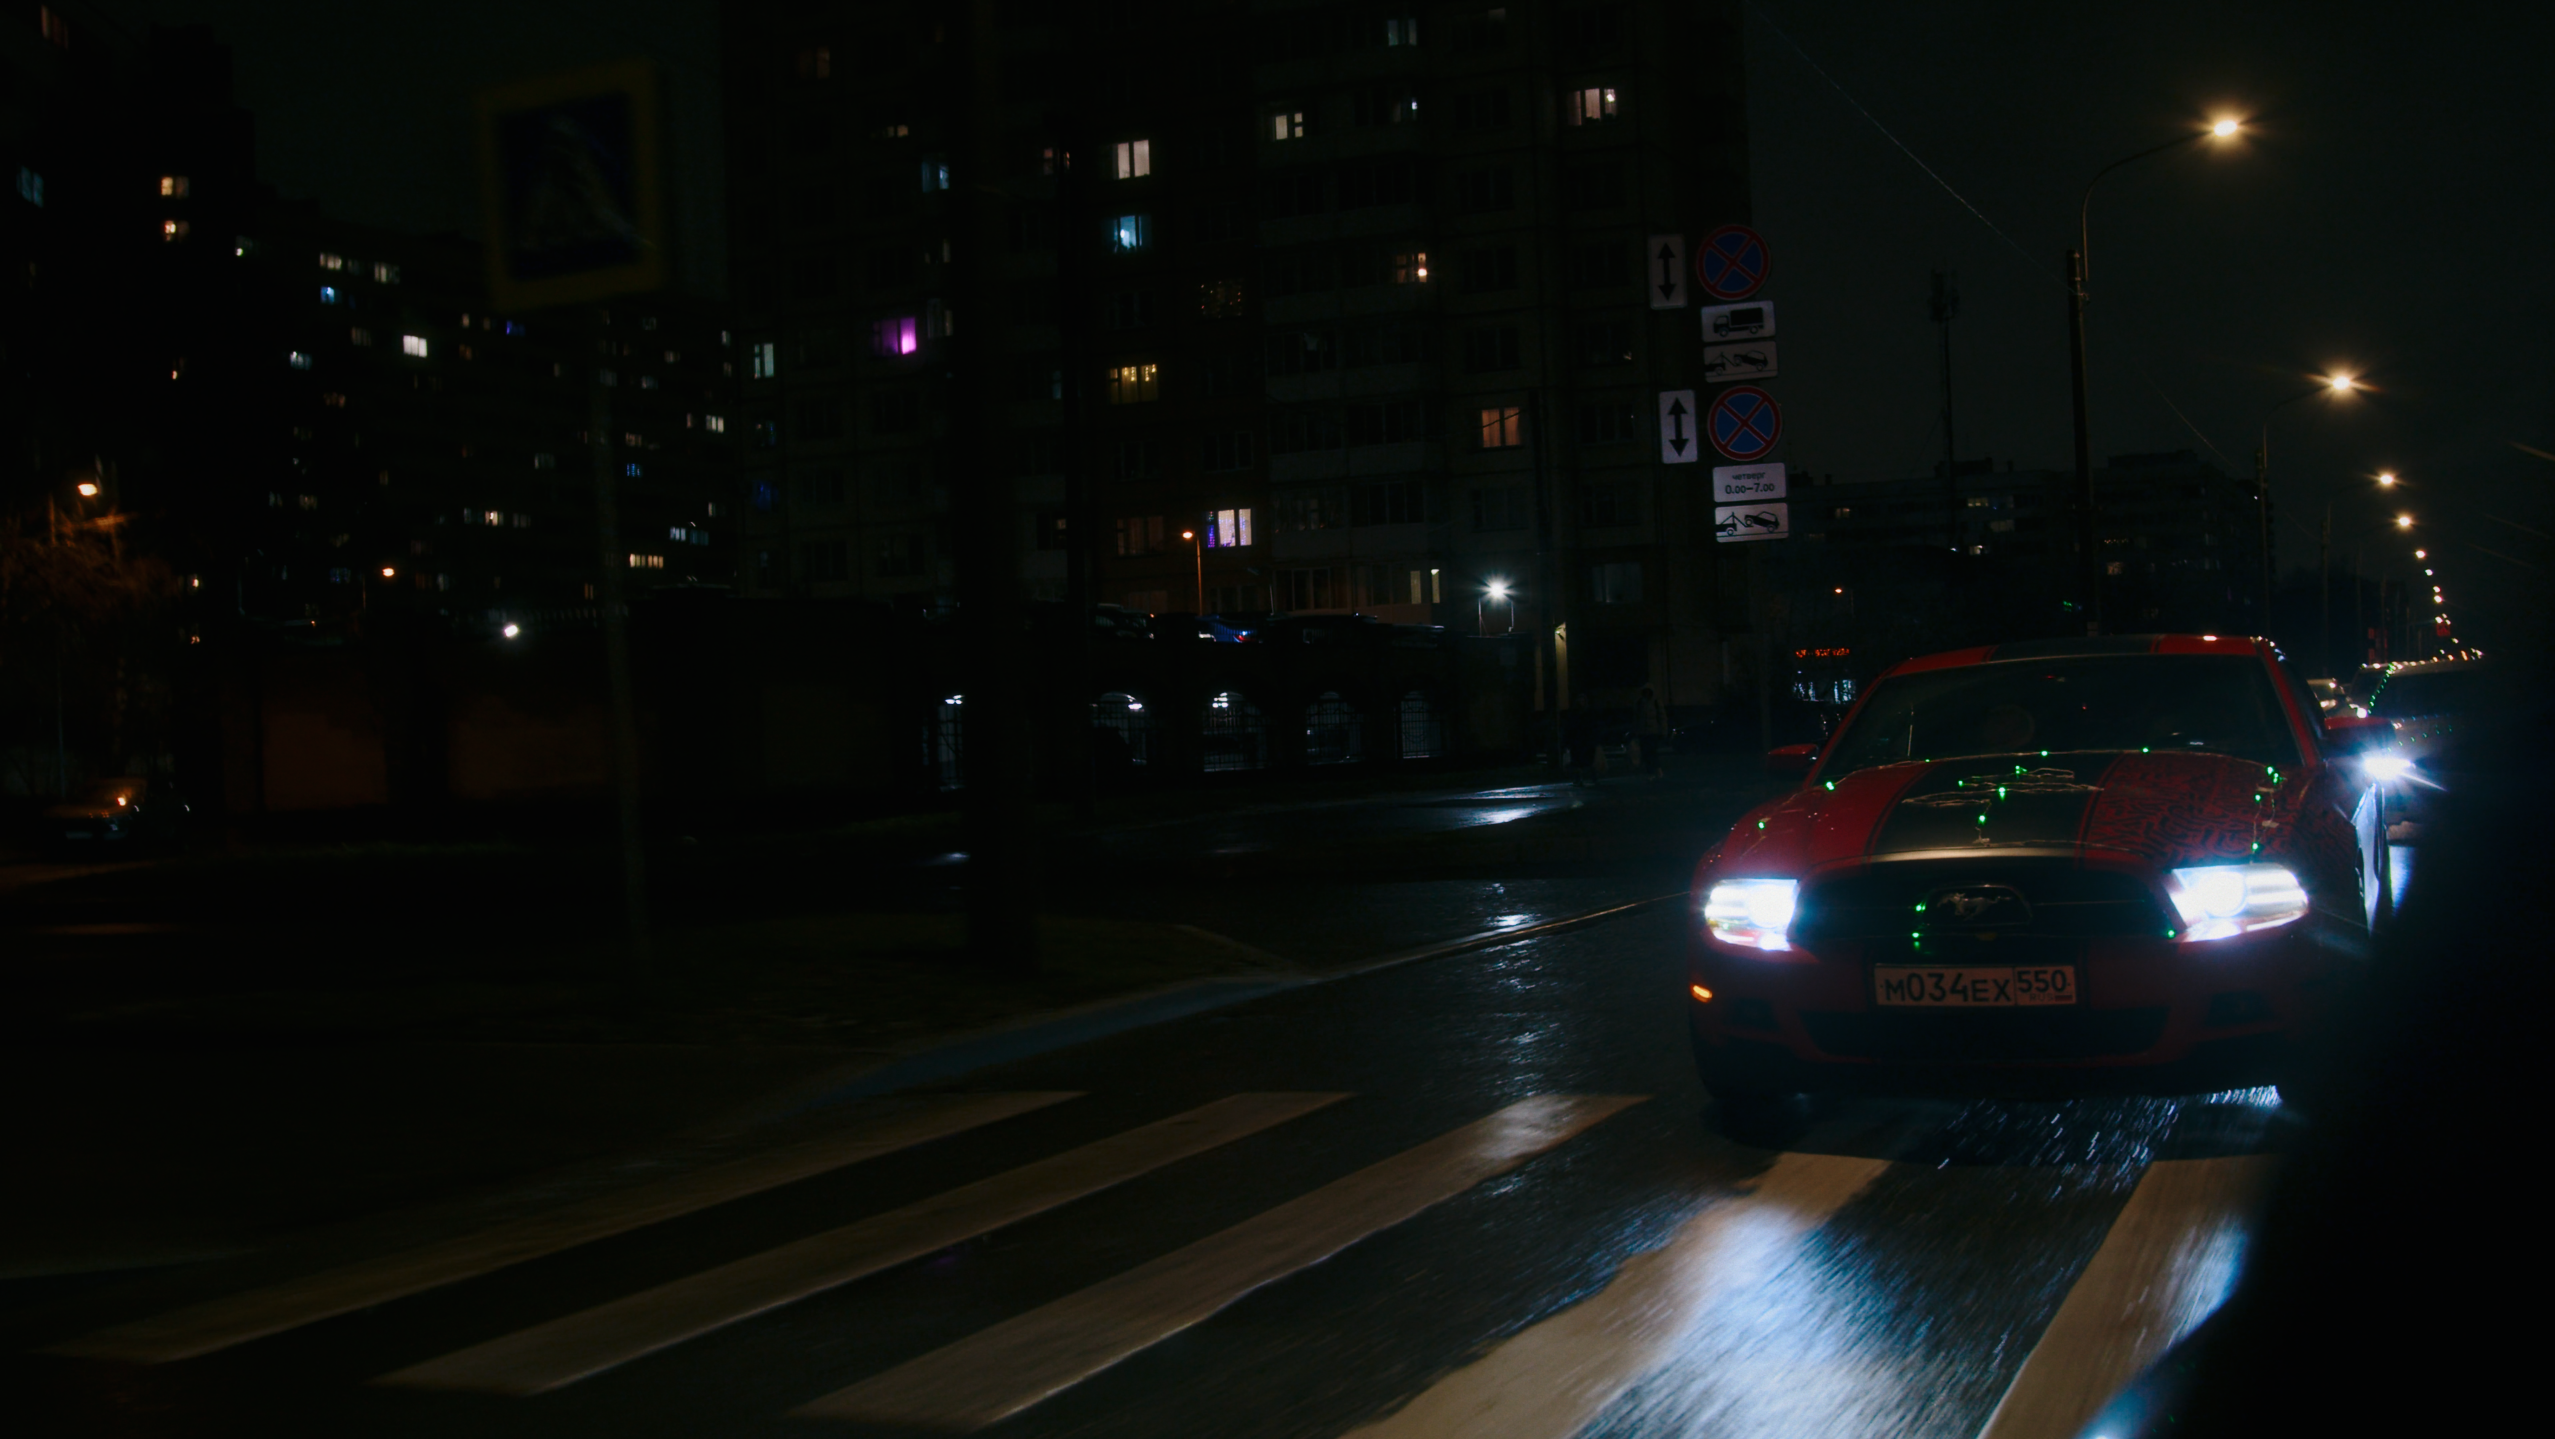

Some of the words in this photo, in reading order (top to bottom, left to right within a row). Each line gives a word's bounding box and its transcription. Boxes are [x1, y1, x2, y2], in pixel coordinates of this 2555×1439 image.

[1732, 472, 1766, 481] четверг
[1884, 972, 2013, 1003] М034ЕХ
[2017, 970, 2067, 993] 550
[2029, 993, 2054, 1002] RUS
